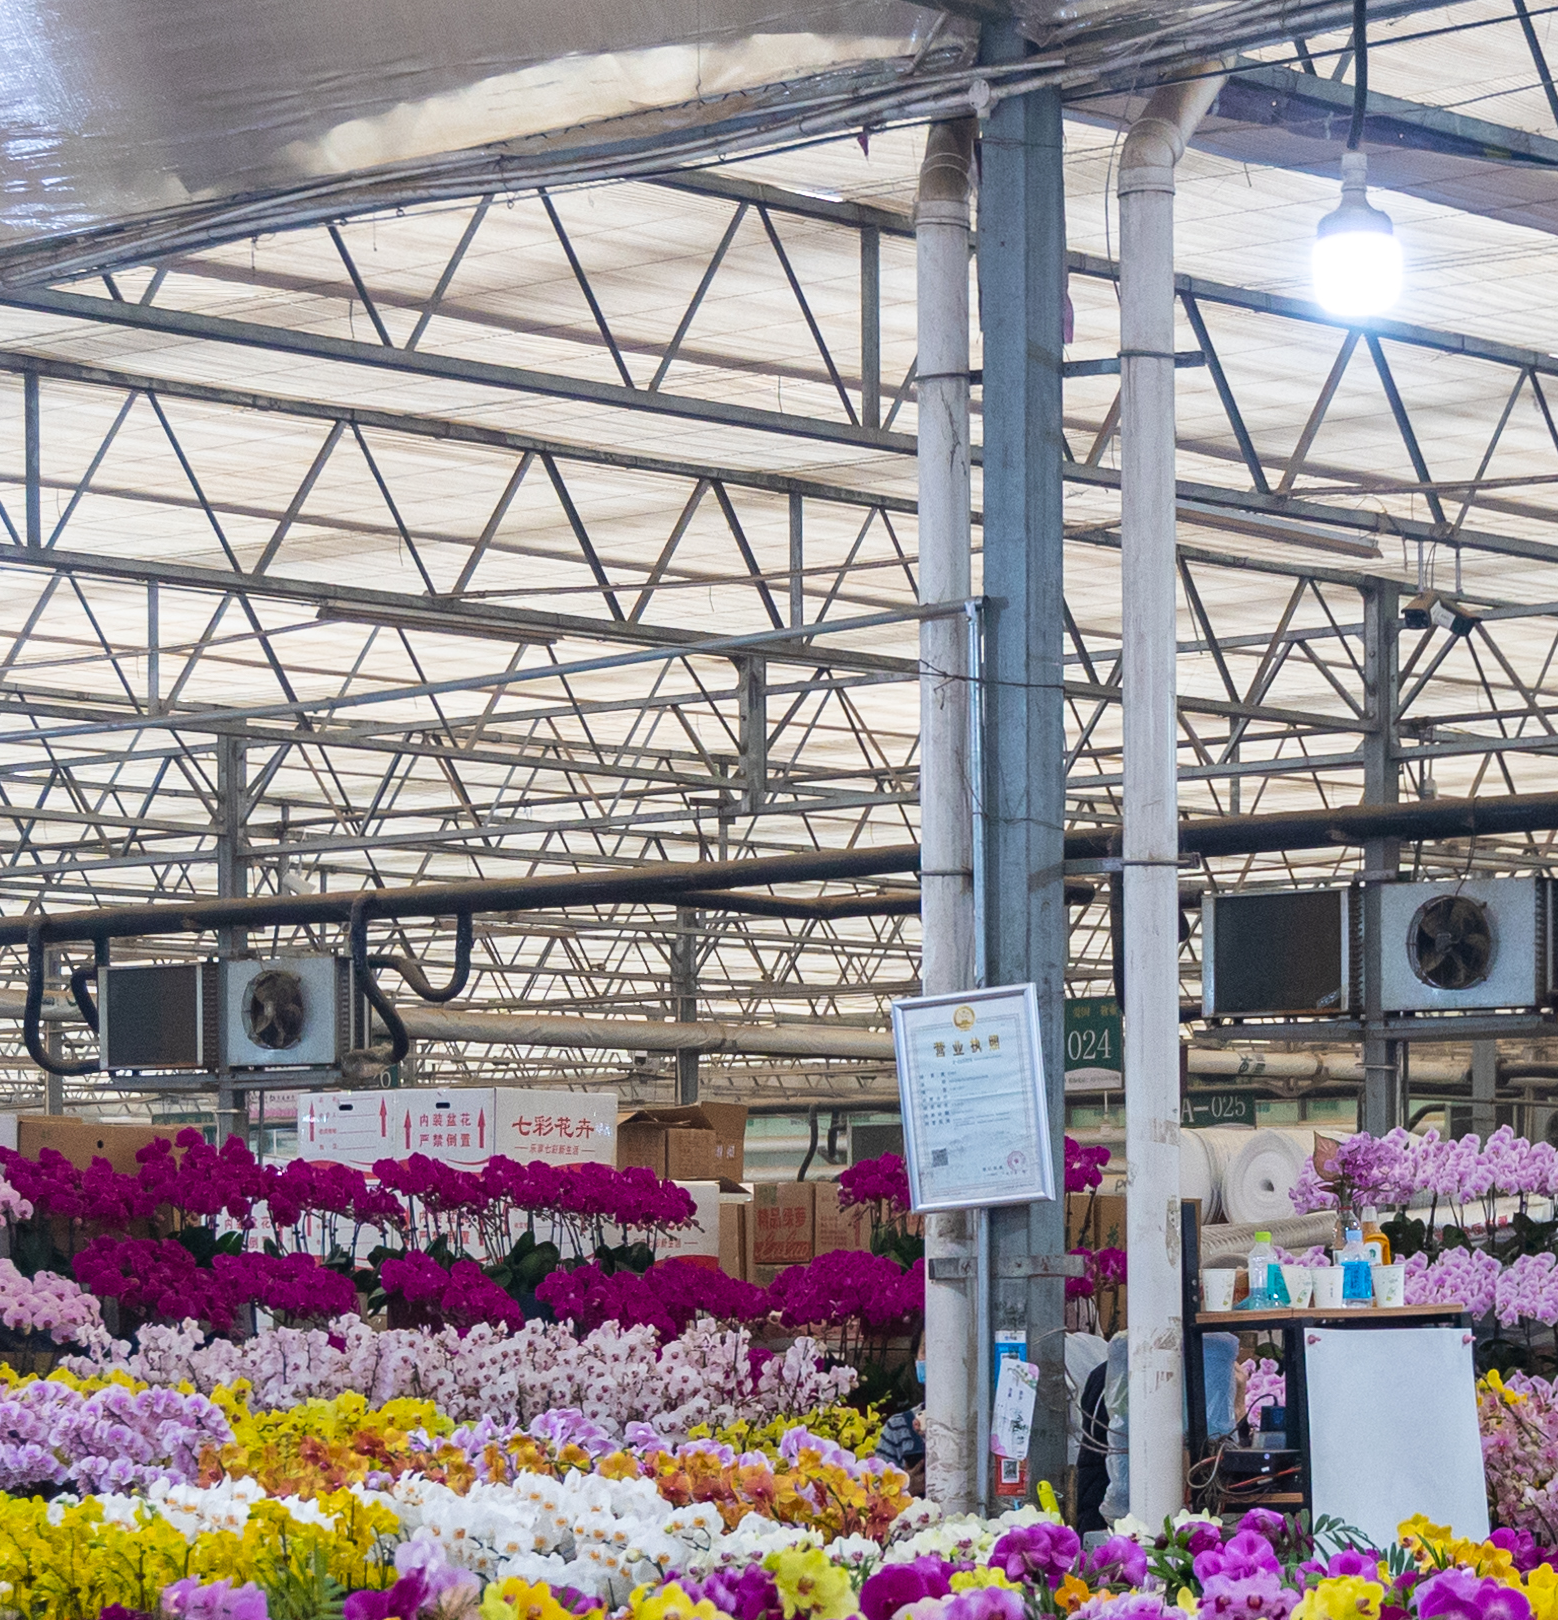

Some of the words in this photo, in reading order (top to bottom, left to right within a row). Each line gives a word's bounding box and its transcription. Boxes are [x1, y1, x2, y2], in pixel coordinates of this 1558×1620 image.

[934, 1034, 1000, 1058] 营业执照
[419, 1112, 472, 1128] 内装盆花
[512, 1115, 595, 1139] 七彩花卉
[419, 1133, 472, 1148] 严禁倒置
